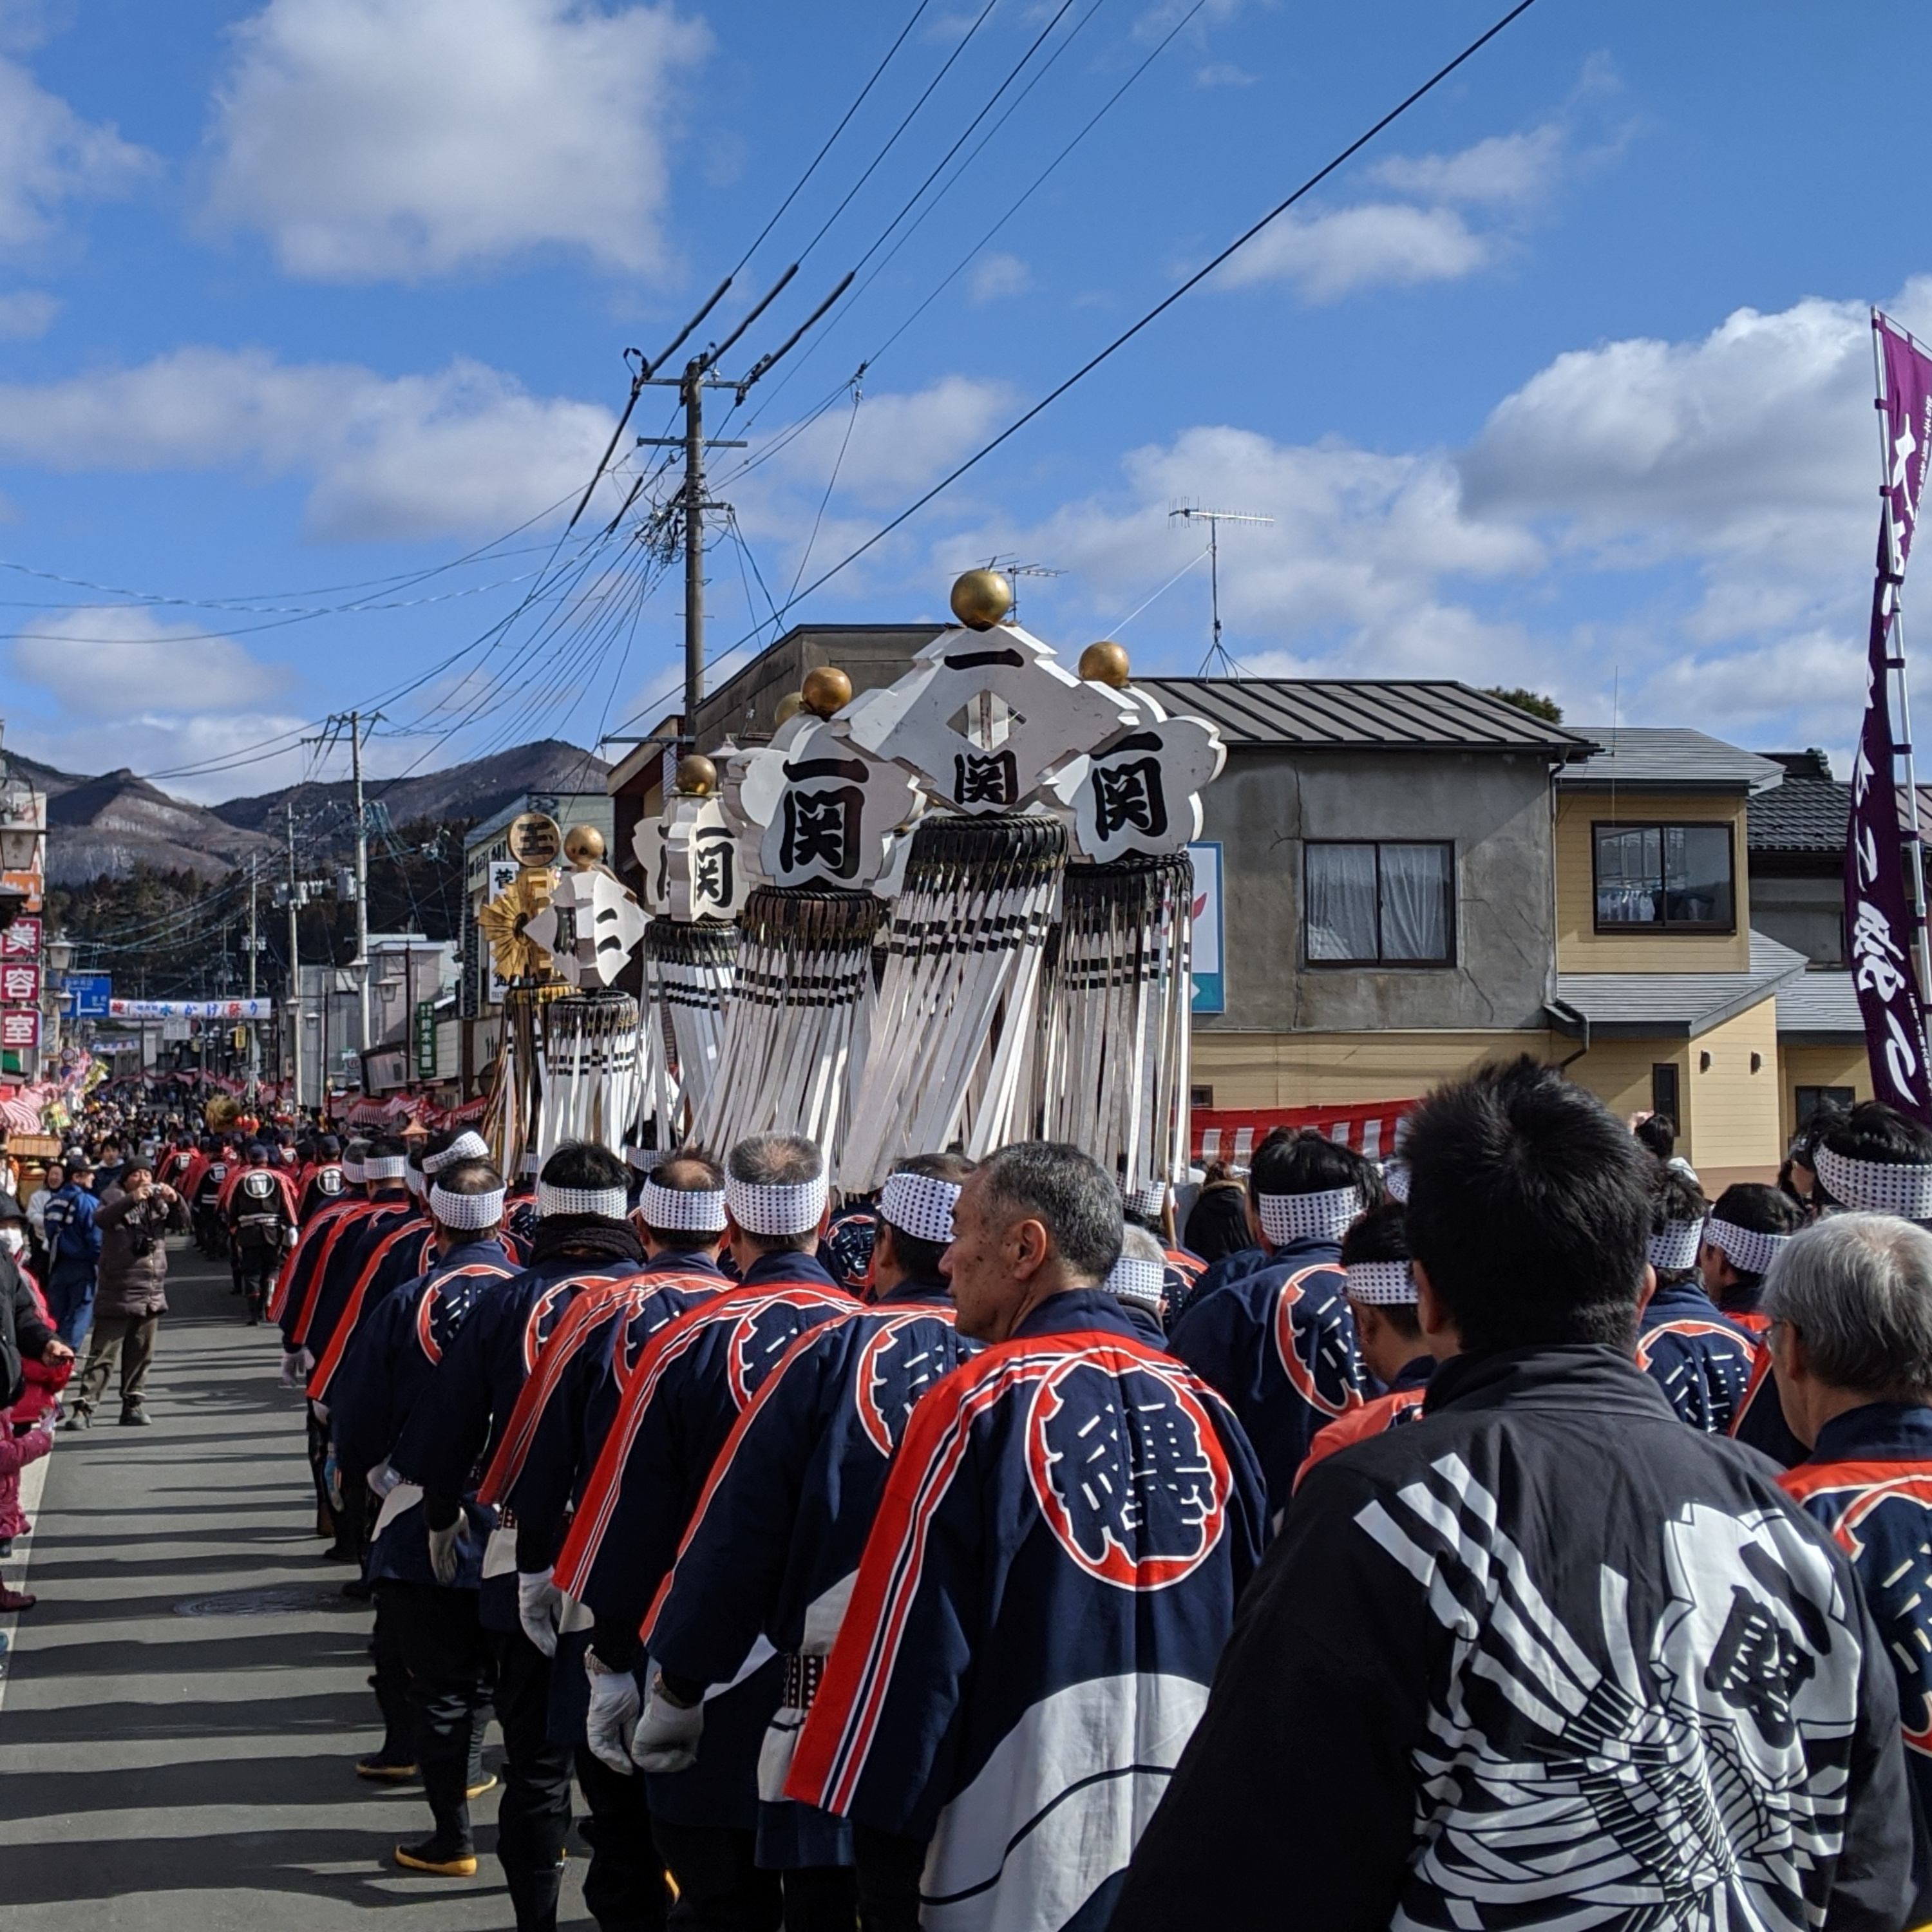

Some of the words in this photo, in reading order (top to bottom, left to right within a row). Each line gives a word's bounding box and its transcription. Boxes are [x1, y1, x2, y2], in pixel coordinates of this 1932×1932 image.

[779, 757, 870, 880] 一関
[1090, 731, 1168, 842] 一関
[5, 921, 37, 1044] 美容室
[160, 1001, 258, 1018] 水かけ祭り
